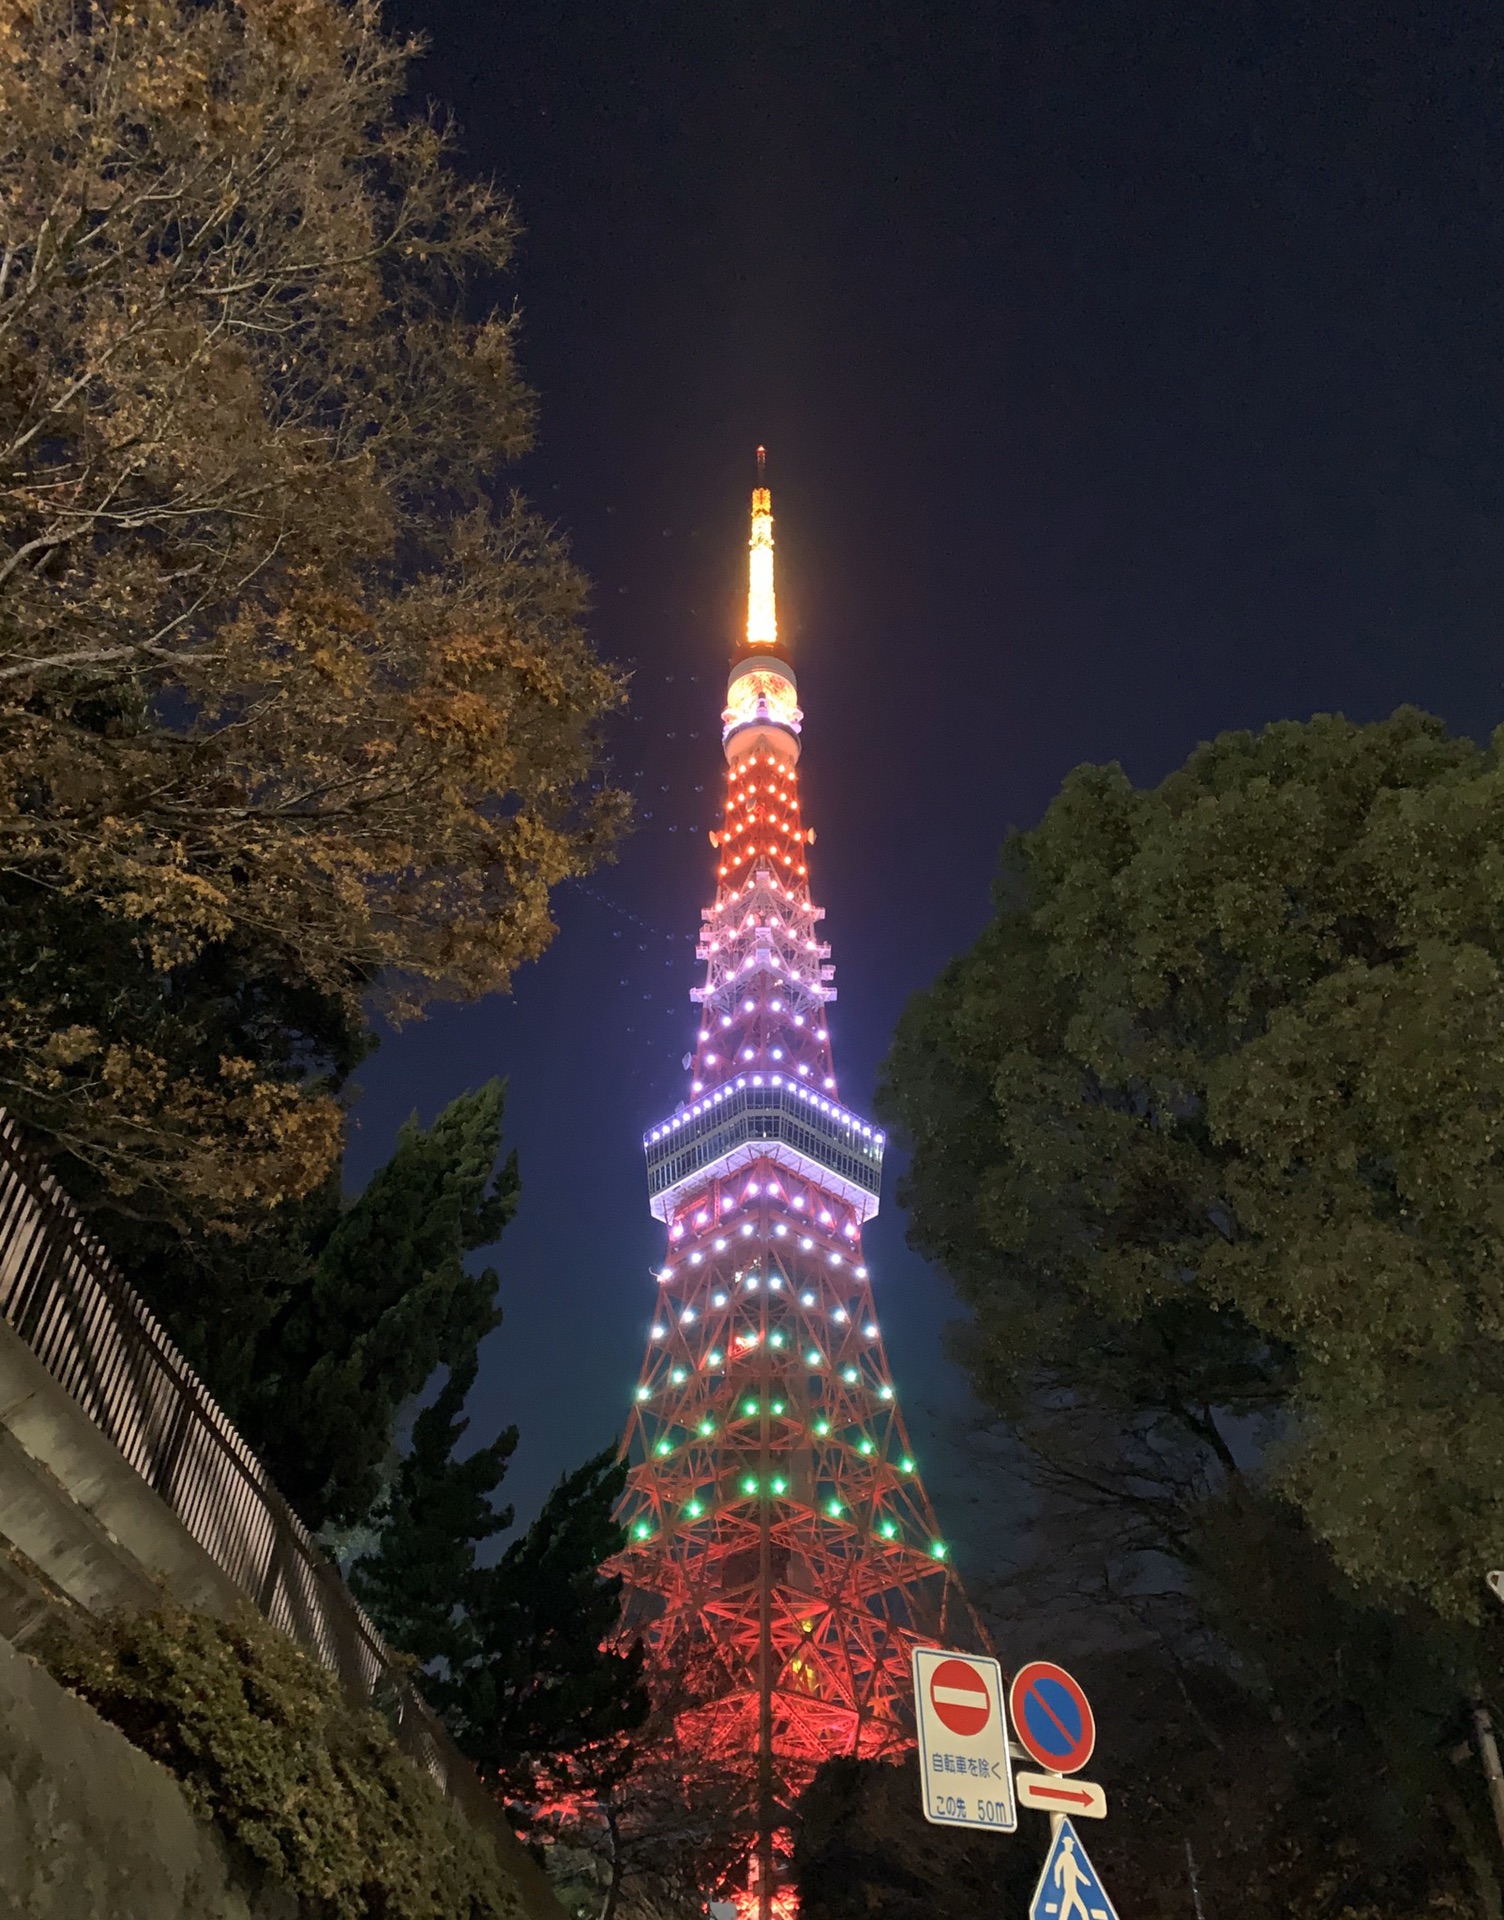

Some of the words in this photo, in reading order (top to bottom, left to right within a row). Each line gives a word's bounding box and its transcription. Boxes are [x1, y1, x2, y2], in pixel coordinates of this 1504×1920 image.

[932, 1752, 1001, 1780] 自転車を除く
[936, 1796, 967, 1818] この先
[977, 1799, 1007, 1823] 50m
